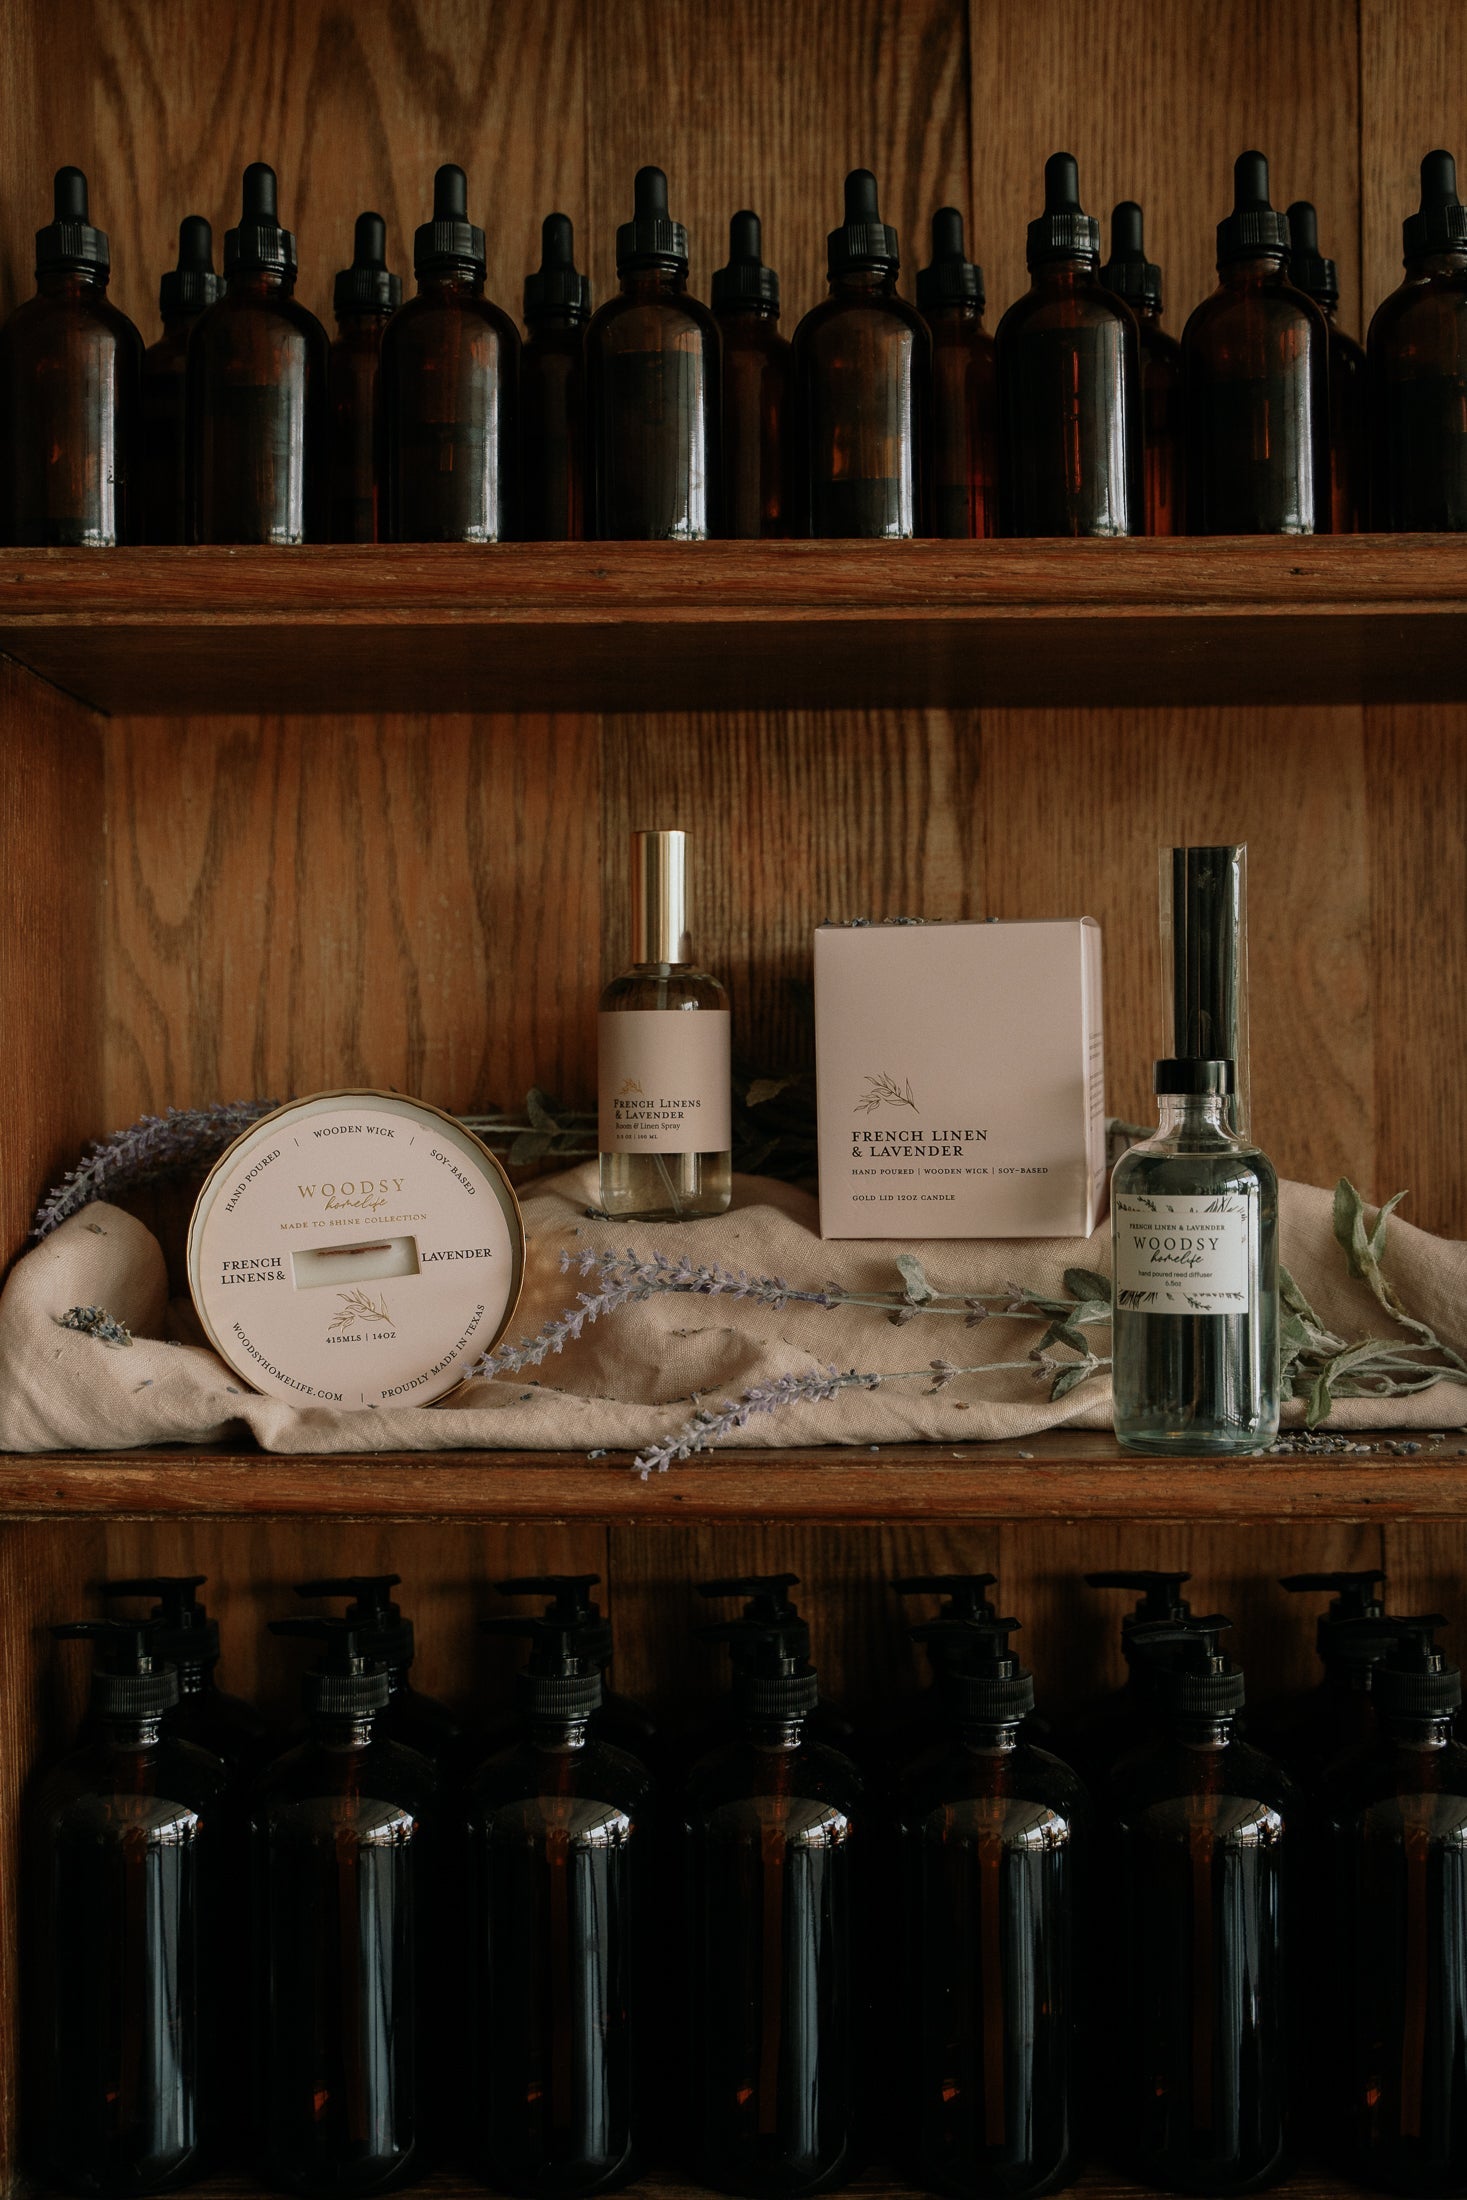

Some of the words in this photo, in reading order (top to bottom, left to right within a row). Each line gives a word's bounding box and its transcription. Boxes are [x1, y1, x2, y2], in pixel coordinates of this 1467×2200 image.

[616, 1110, 622, 1119] &
[313, 1125, 362, 1138] WOODEN
[366, 1126, 395, 1138] WICK
[852, 1131, 923, 1142] FRENCH
[932, 1130, 988, 1141] LINEN
[852, 1146, 862, 1157] &
[870, 1146, 964, 1157] LAVENDER
[430, 1149, 476, 1195] SOY-BASED
[225, 1182, 246, 1212] HAND
[245, 1149, 281, 1182] POURED
[298, 1179, 404, 1198] WOODSY
[325, 1194, 388, 1212] homelife
[280, 1222, 308, 1230] MADE
[329, 1218, 361, 1226] SHINE
[364, 1214, 427, 1224] COLLECTION
[1134, 1236, 1219, 1250] WOODSY
[422, 1248, 492, 1262] LAVENDER
[1150, 1250, 1204, 1268] homelife
[222, 1257, 282, 1270] FRENCH
[326, 1335, 361, 1344] 415MLS
[373, 1331, 397, 1340] 14OZ
[381, 1372, 429, 1398] PROUDLY
[431, 1350, 457, 1375] MADE
[456, 1337, 467, 1350] IN
[465, 1304, 485, 1338] TEXAS
[233, 1322, 343, 1401] WOODSYHOMELIFE.COM
